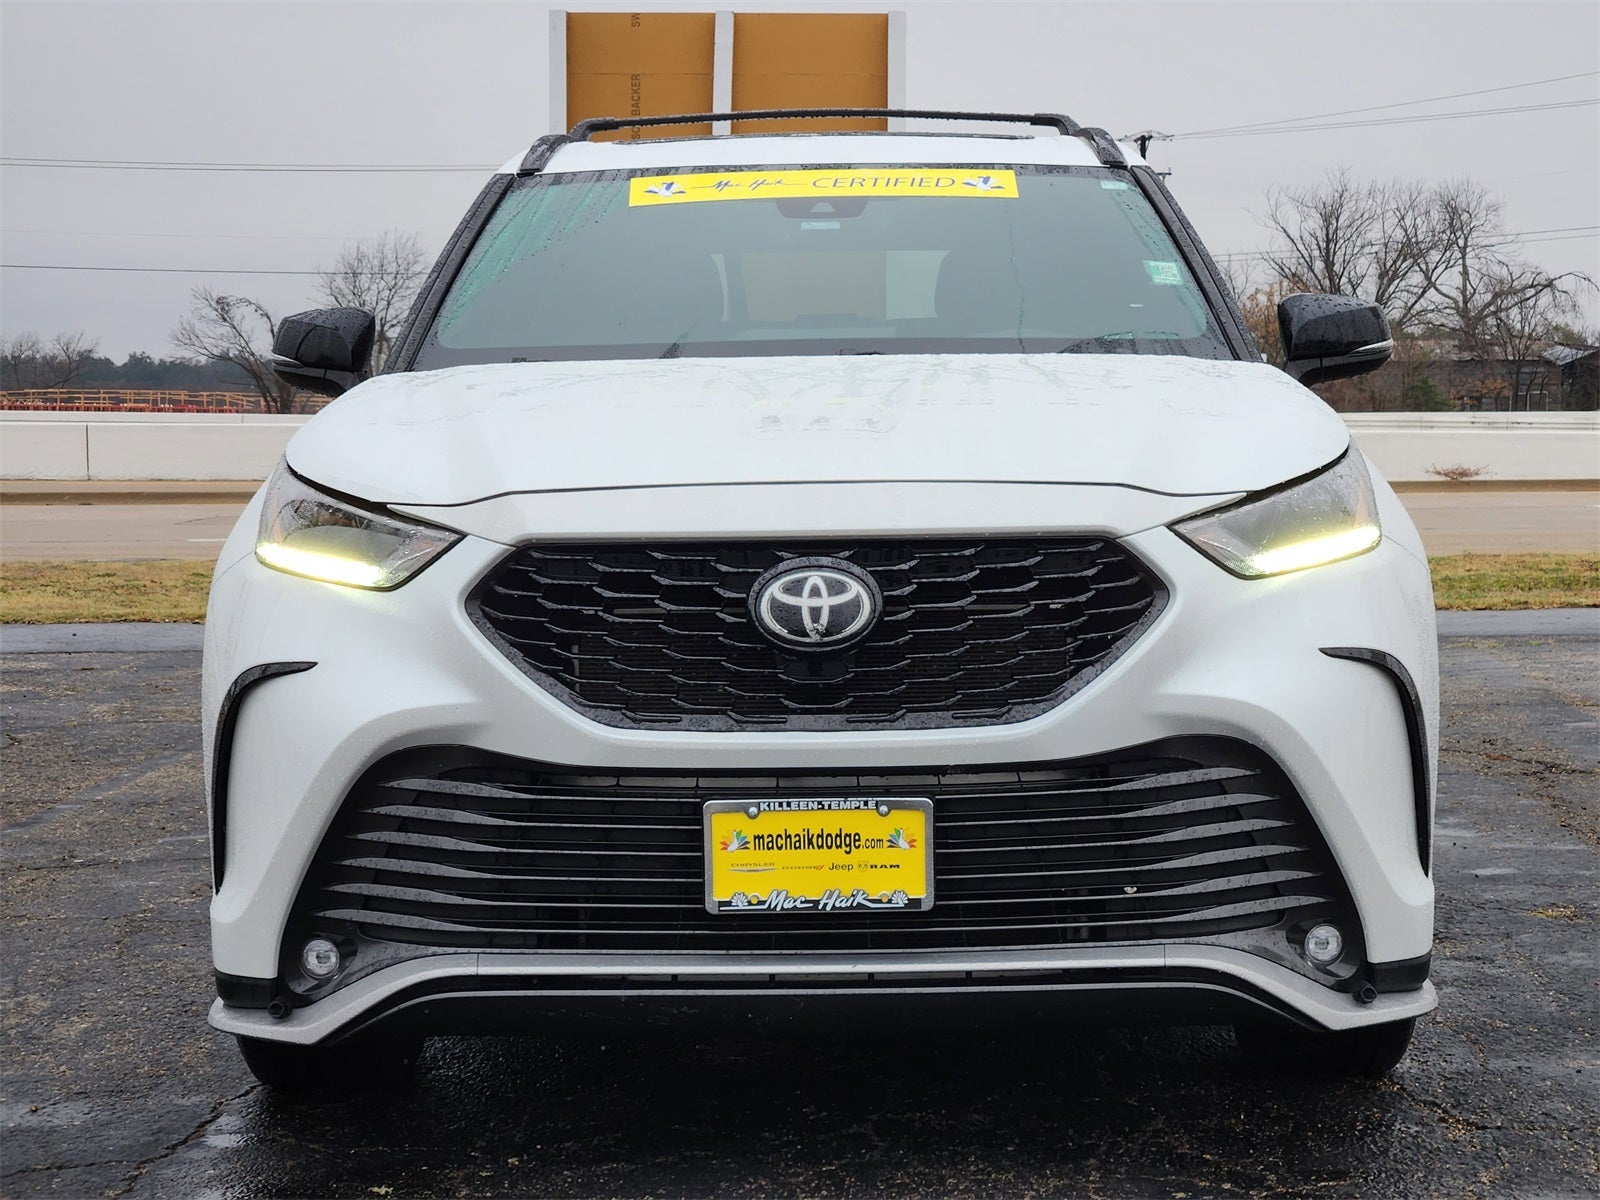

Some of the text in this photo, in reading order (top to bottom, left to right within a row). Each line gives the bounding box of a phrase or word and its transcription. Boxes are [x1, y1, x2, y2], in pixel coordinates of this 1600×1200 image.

[631, 73, 641, 116] BACKER
[812, 177, 956, 189] CERTIFIED
[759, 800, 877, 811] KILLEEN-TEMPLE
[753, 828, 884, 854] machaikdodge.com
[828, 863, 854, 871] Jeep
[764, 889, 870, 911] Mac Haik
